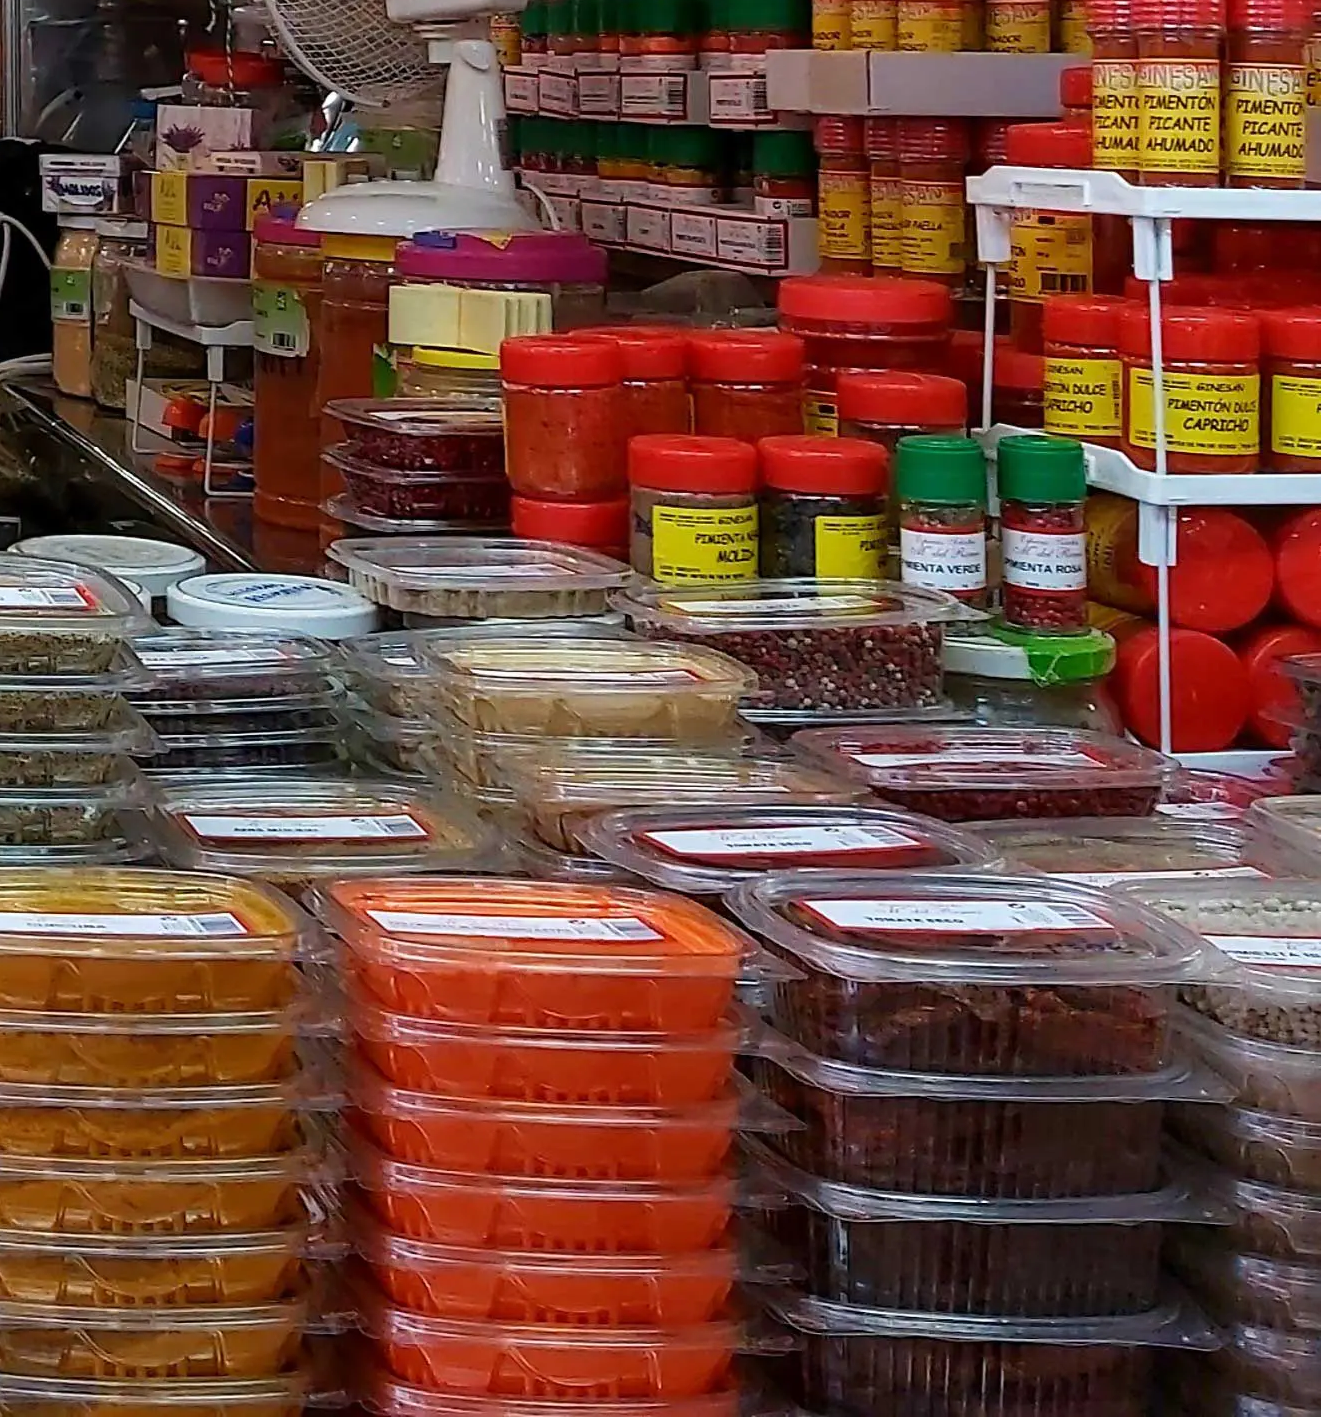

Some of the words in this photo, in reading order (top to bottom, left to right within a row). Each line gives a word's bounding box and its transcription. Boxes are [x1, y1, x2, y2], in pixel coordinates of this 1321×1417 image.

[1149, 116, 1211, 132] PICANTE
[1242, 120, 1303, 138] PICANTE
[1146, 137, 1215, 153] AHUMADO
[1073, 382, 1107, 396] DULCE
[1183, 417, 1249, 433] CAPRICHO
[947, 563, 981, 574] VERDE
[1056, 564, 1082, 574] ROSA
